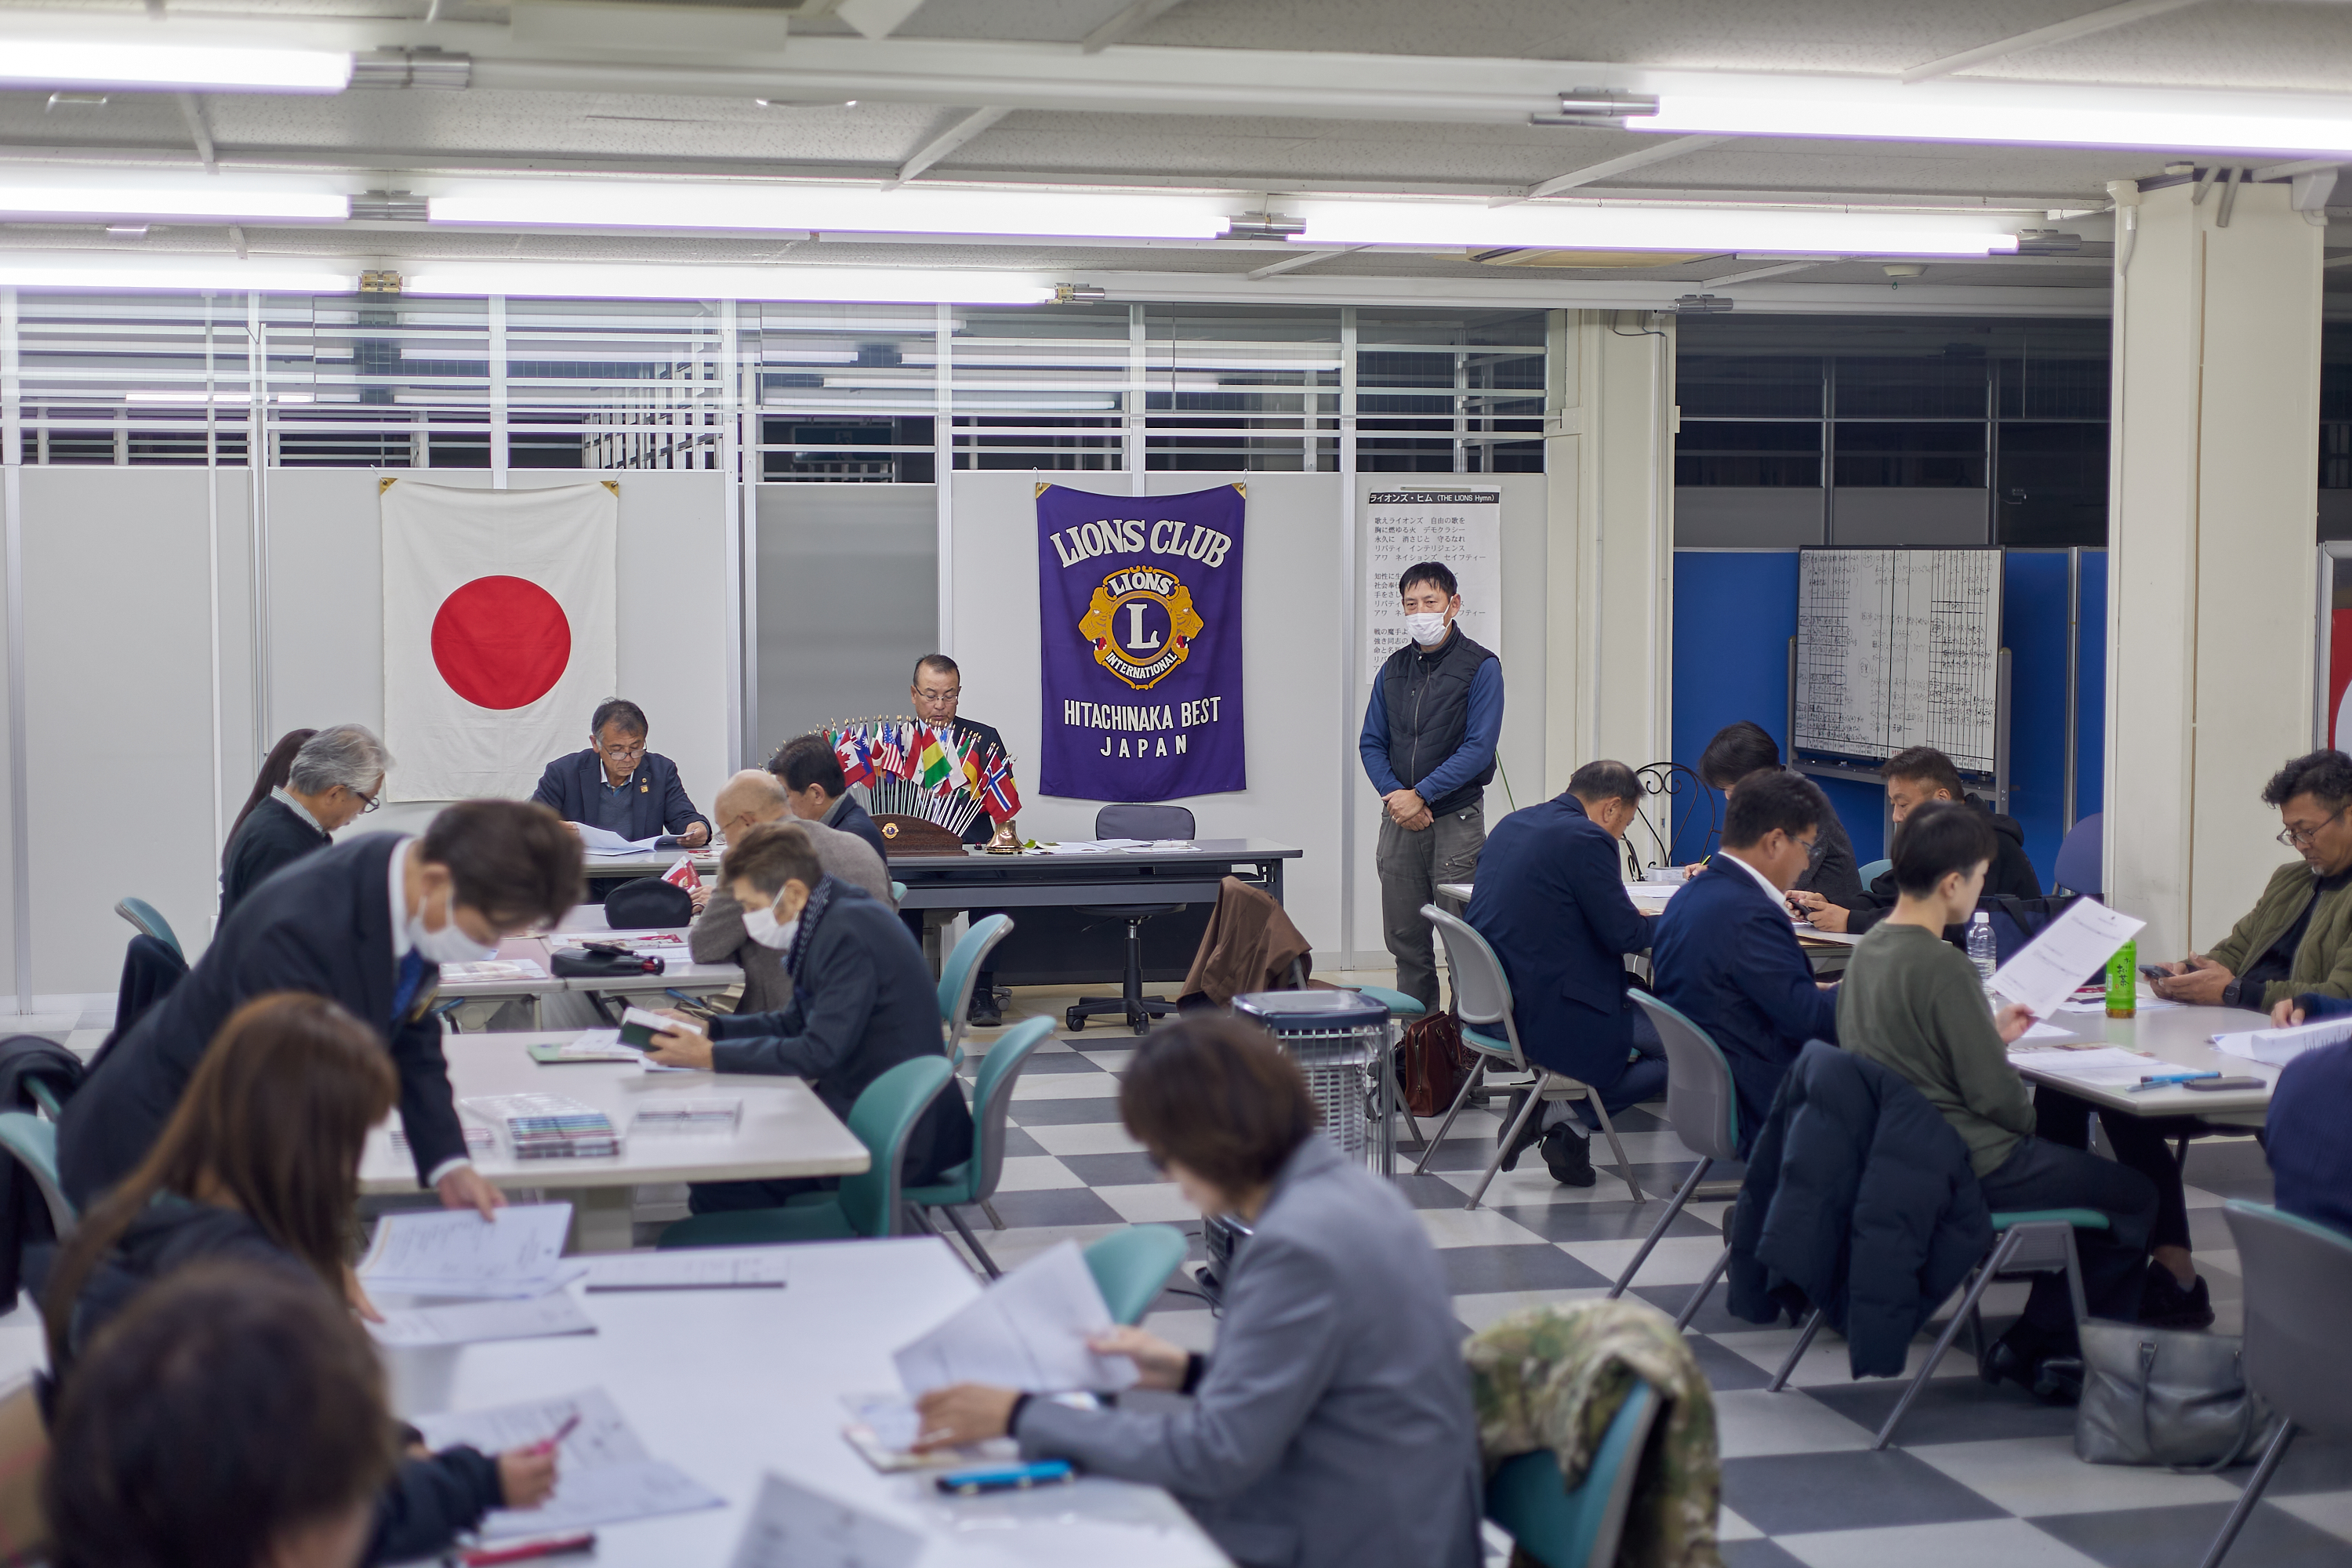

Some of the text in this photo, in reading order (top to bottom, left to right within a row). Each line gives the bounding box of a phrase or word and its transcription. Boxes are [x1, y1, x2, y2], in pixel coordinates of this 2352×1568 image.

[1370, 494, 1433, 503] ライオンズ・ヒム
[1454, 494, 1472, 503] LIONS
[1050, 519, 1232, 568] LIONS CLUB
[1108, 572, 1174, 596] LIONS
[1126, 603, 1160, 649] L
[1105, 652, 1178, 680] INTERNATIONAL
[1064, 696, 1221, 731] HITACHINAKA BEST
[1100, 735, 1187, 758] JAPAN
